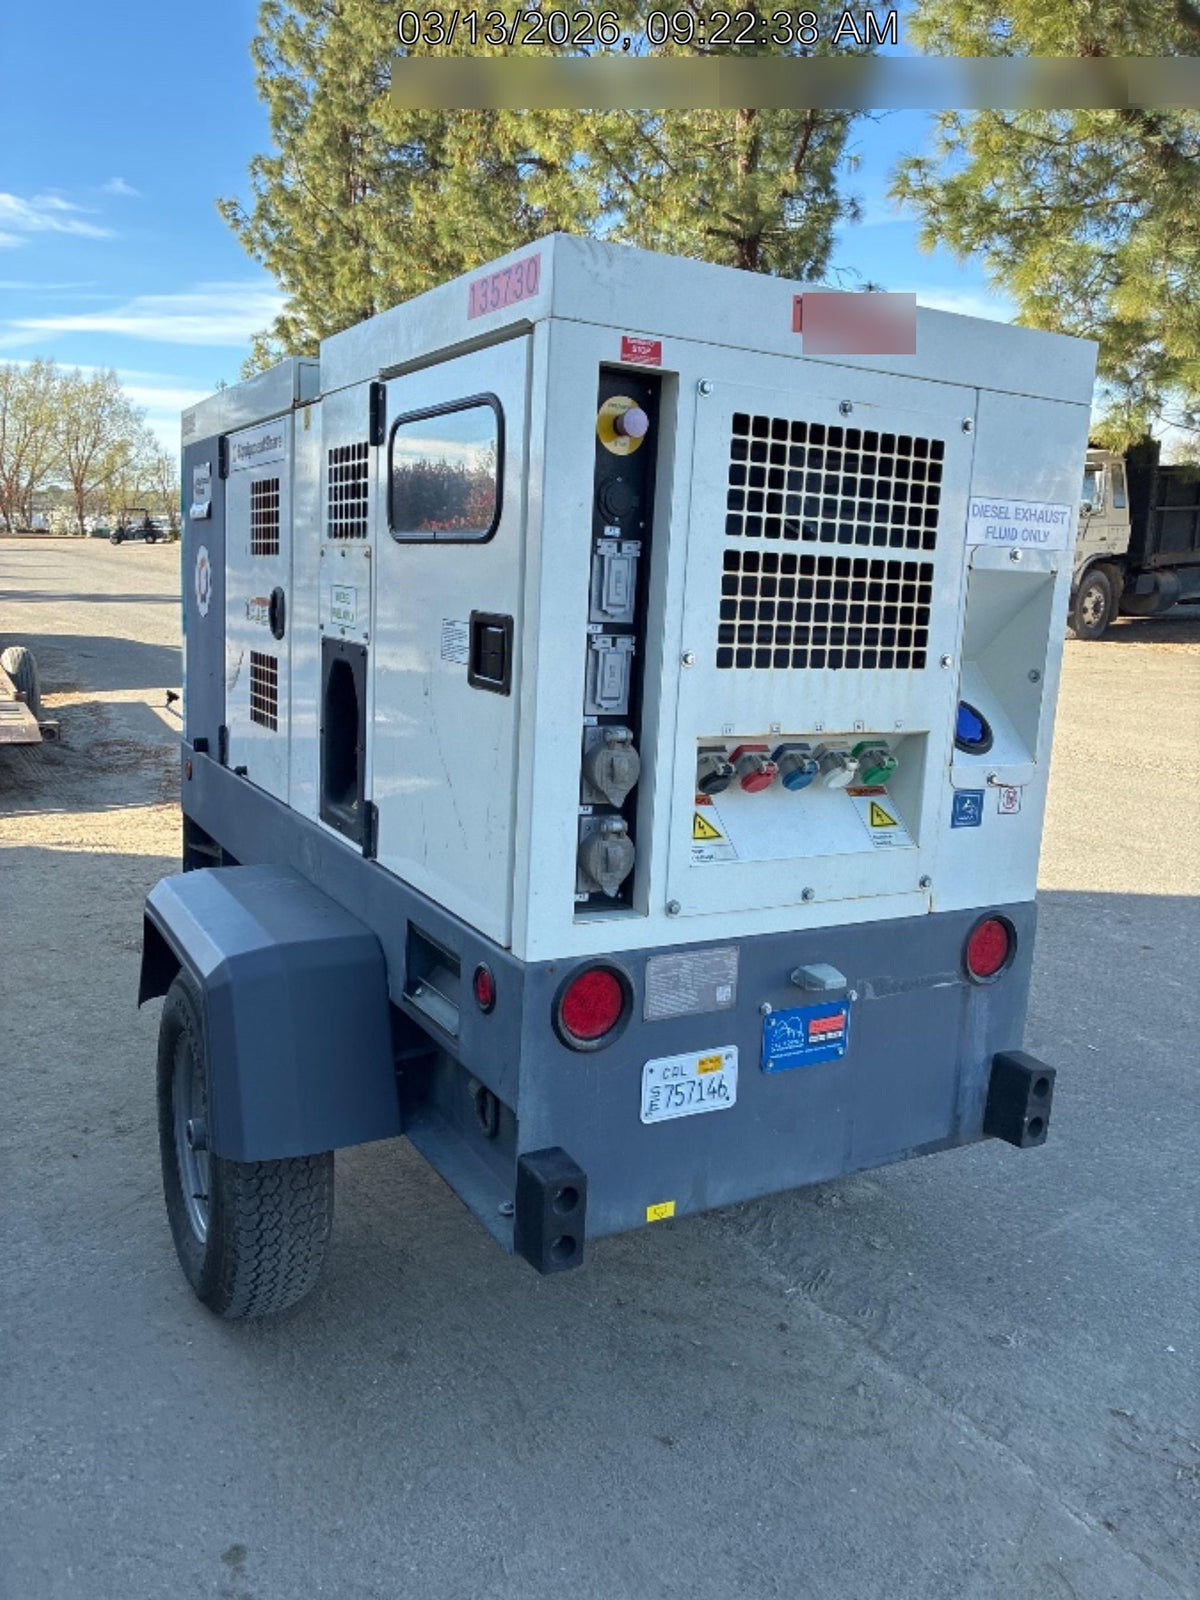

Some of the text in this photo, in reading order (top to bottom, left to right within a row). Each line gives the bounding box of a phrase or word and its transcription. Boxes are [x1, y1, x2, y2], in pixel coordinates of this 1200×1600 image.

[471, 256, 539, 315] 135730
[972, 504, 1067, 525] DIESEL EXHAUST
[985, 526, 1050, 543] FLUID ONLY
[662, 1065, 688, 1080] CAL
[664, 1074, 728, 1108] 757146
